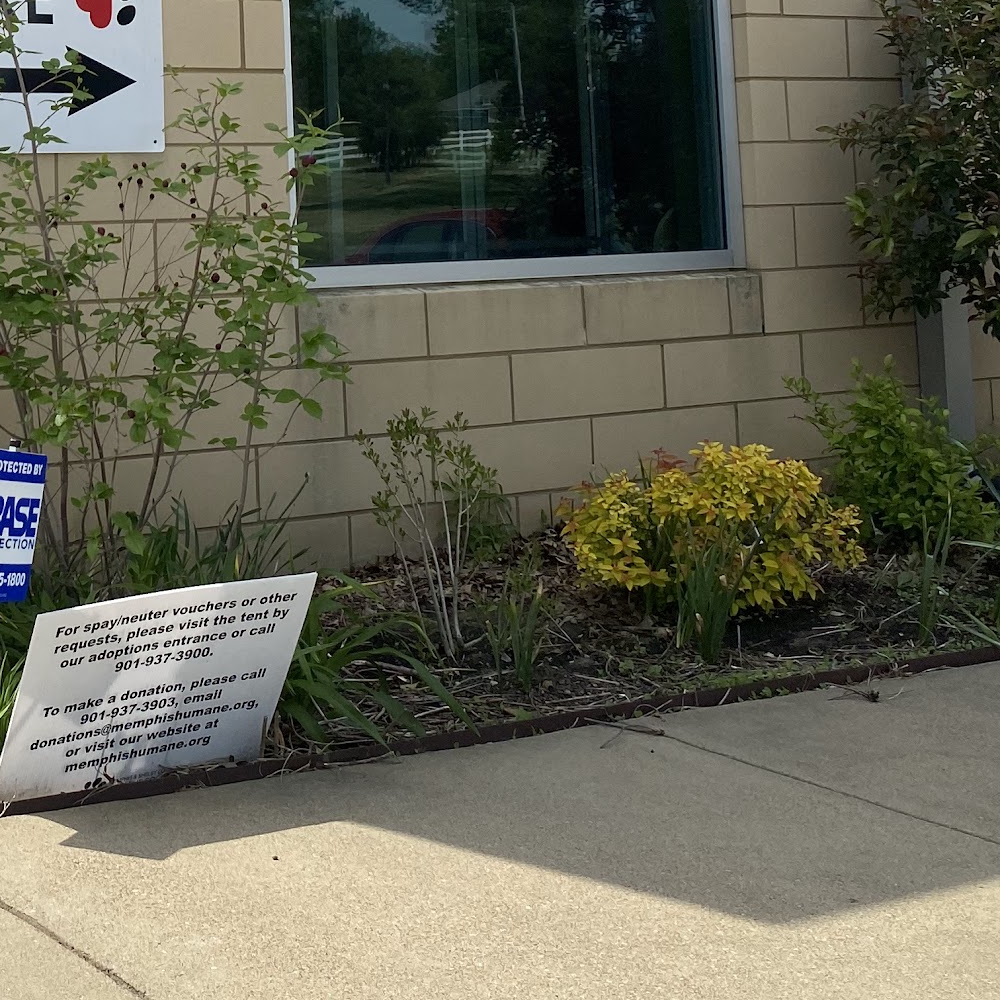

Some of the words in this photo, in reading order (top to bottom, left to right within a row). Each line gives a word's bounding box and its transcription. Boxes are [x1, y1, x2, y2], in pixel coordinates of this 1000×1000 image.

[33, 463, 43, 476] BY
[54, 634, 122, 654] requests,
[126, 624, 174, 642] please
[179, 617, 209, 630] visit
[213, 614, 236, 626] the
[241, 609, 269, 622] tent
[272, 607, 290, 620] by
[55, 625, 80, 638] For
[83, 609, 169, 634] spay/neuter
[173, 600, 237, 616] vouchers
[241, 597, 257, 607] or
[260, 592, 297, 604] other
[60, 656, 85, 668] our
[88, 641, 159, 663] adoptions
[163, 631, 227, 648] entrance
[231, 628, 247, 638] or
[249, 623, 276, 636] call
[115, 647, 213, 672] 901-937-3900.
[43, 706, 60, 718] To
[63, 698, 104, 714] make
[107, 695, 116, 704] a
[120, 683, 185, 701] donation,
[190, 674, 237, 691] please
[240, 668, 267, 681] call
[80, 697, 178, 725] 901-937-3903,
[183, 689, 223, 705] email
[30, 699, 258, 751] donations@memphishumane.org,
[65, 747, 81, 758] or
[85, 739, 115, 754] visit
[119, 734, 143, 746] our
[147, 723, 201, 741] website
[205, 718, 219, 730] at
[64, 735, 211, 773] memphishumane.org
